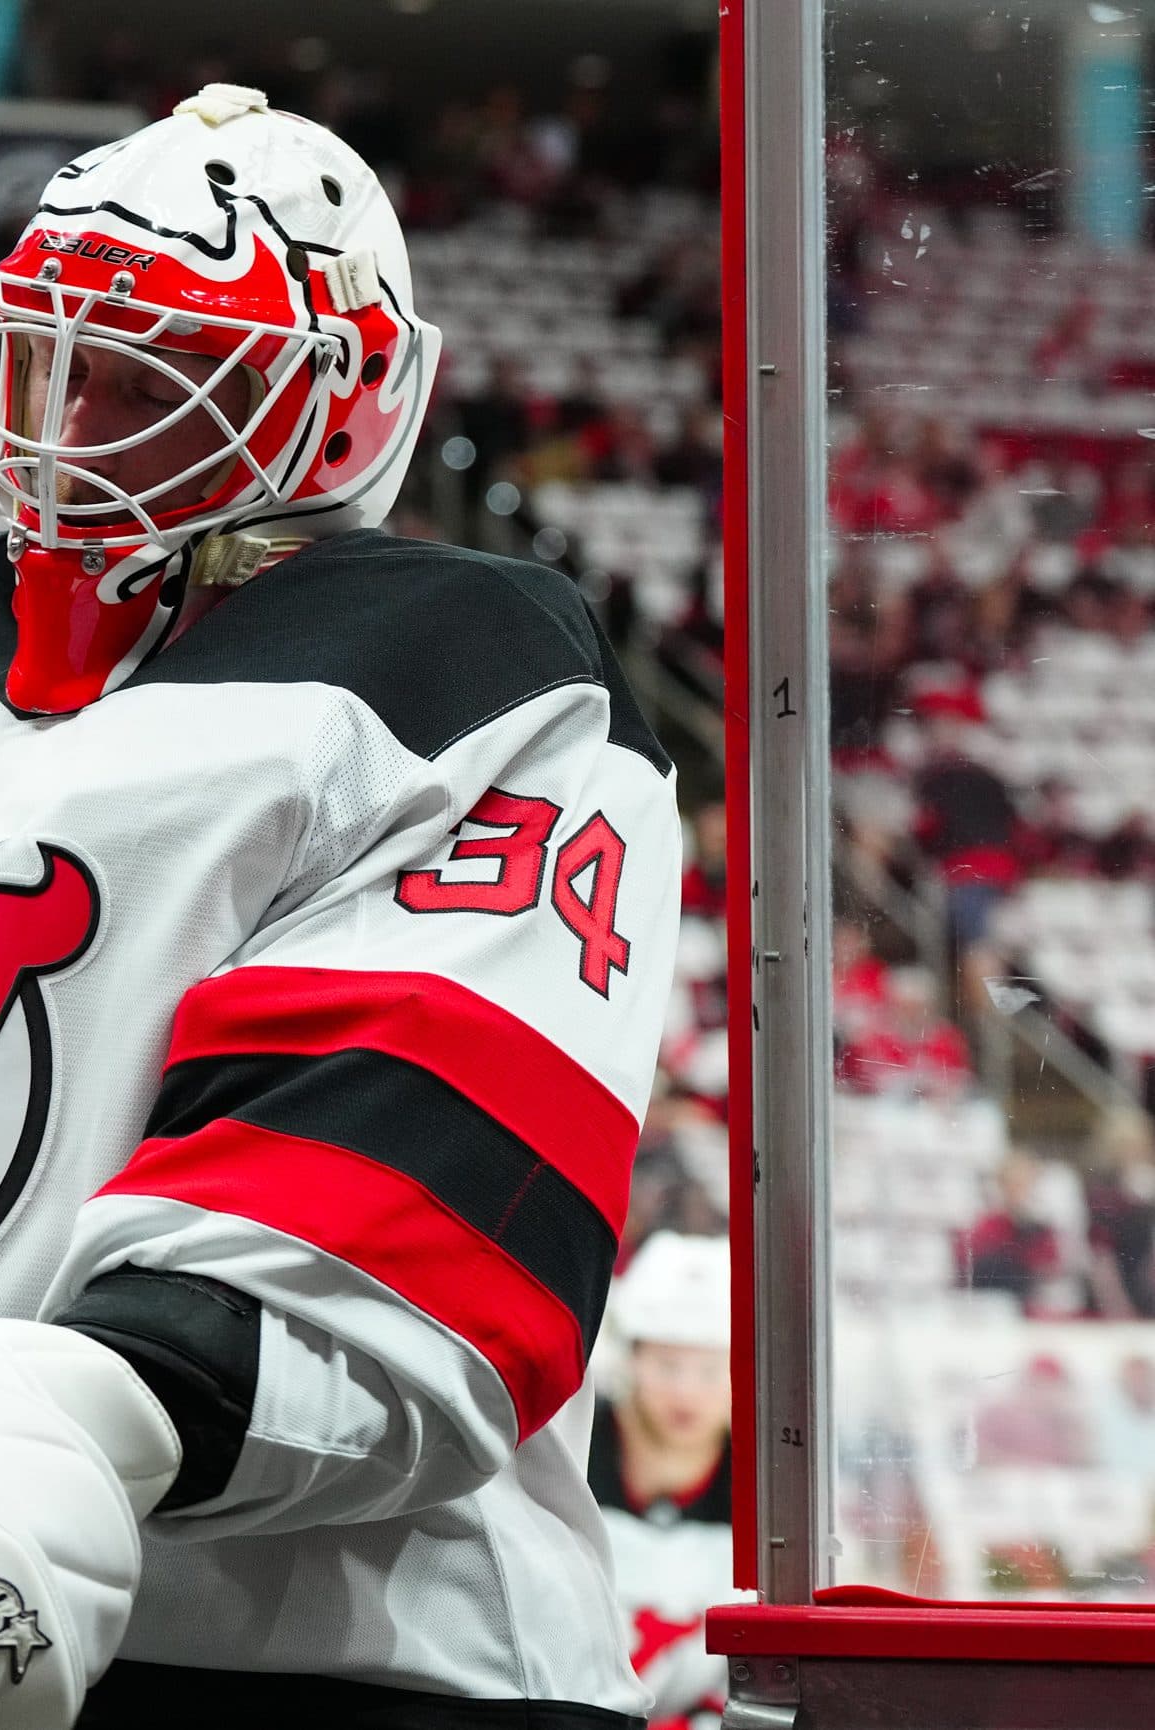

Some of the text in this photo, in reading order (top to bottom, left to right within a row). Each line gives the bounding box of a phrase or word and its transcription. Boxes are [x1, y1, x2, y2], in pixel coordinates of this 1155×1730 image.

[38, 234, 157, 272] BAUER
[773, 676, 797, 719] 1
[393, 785, 631, 1001] 34
